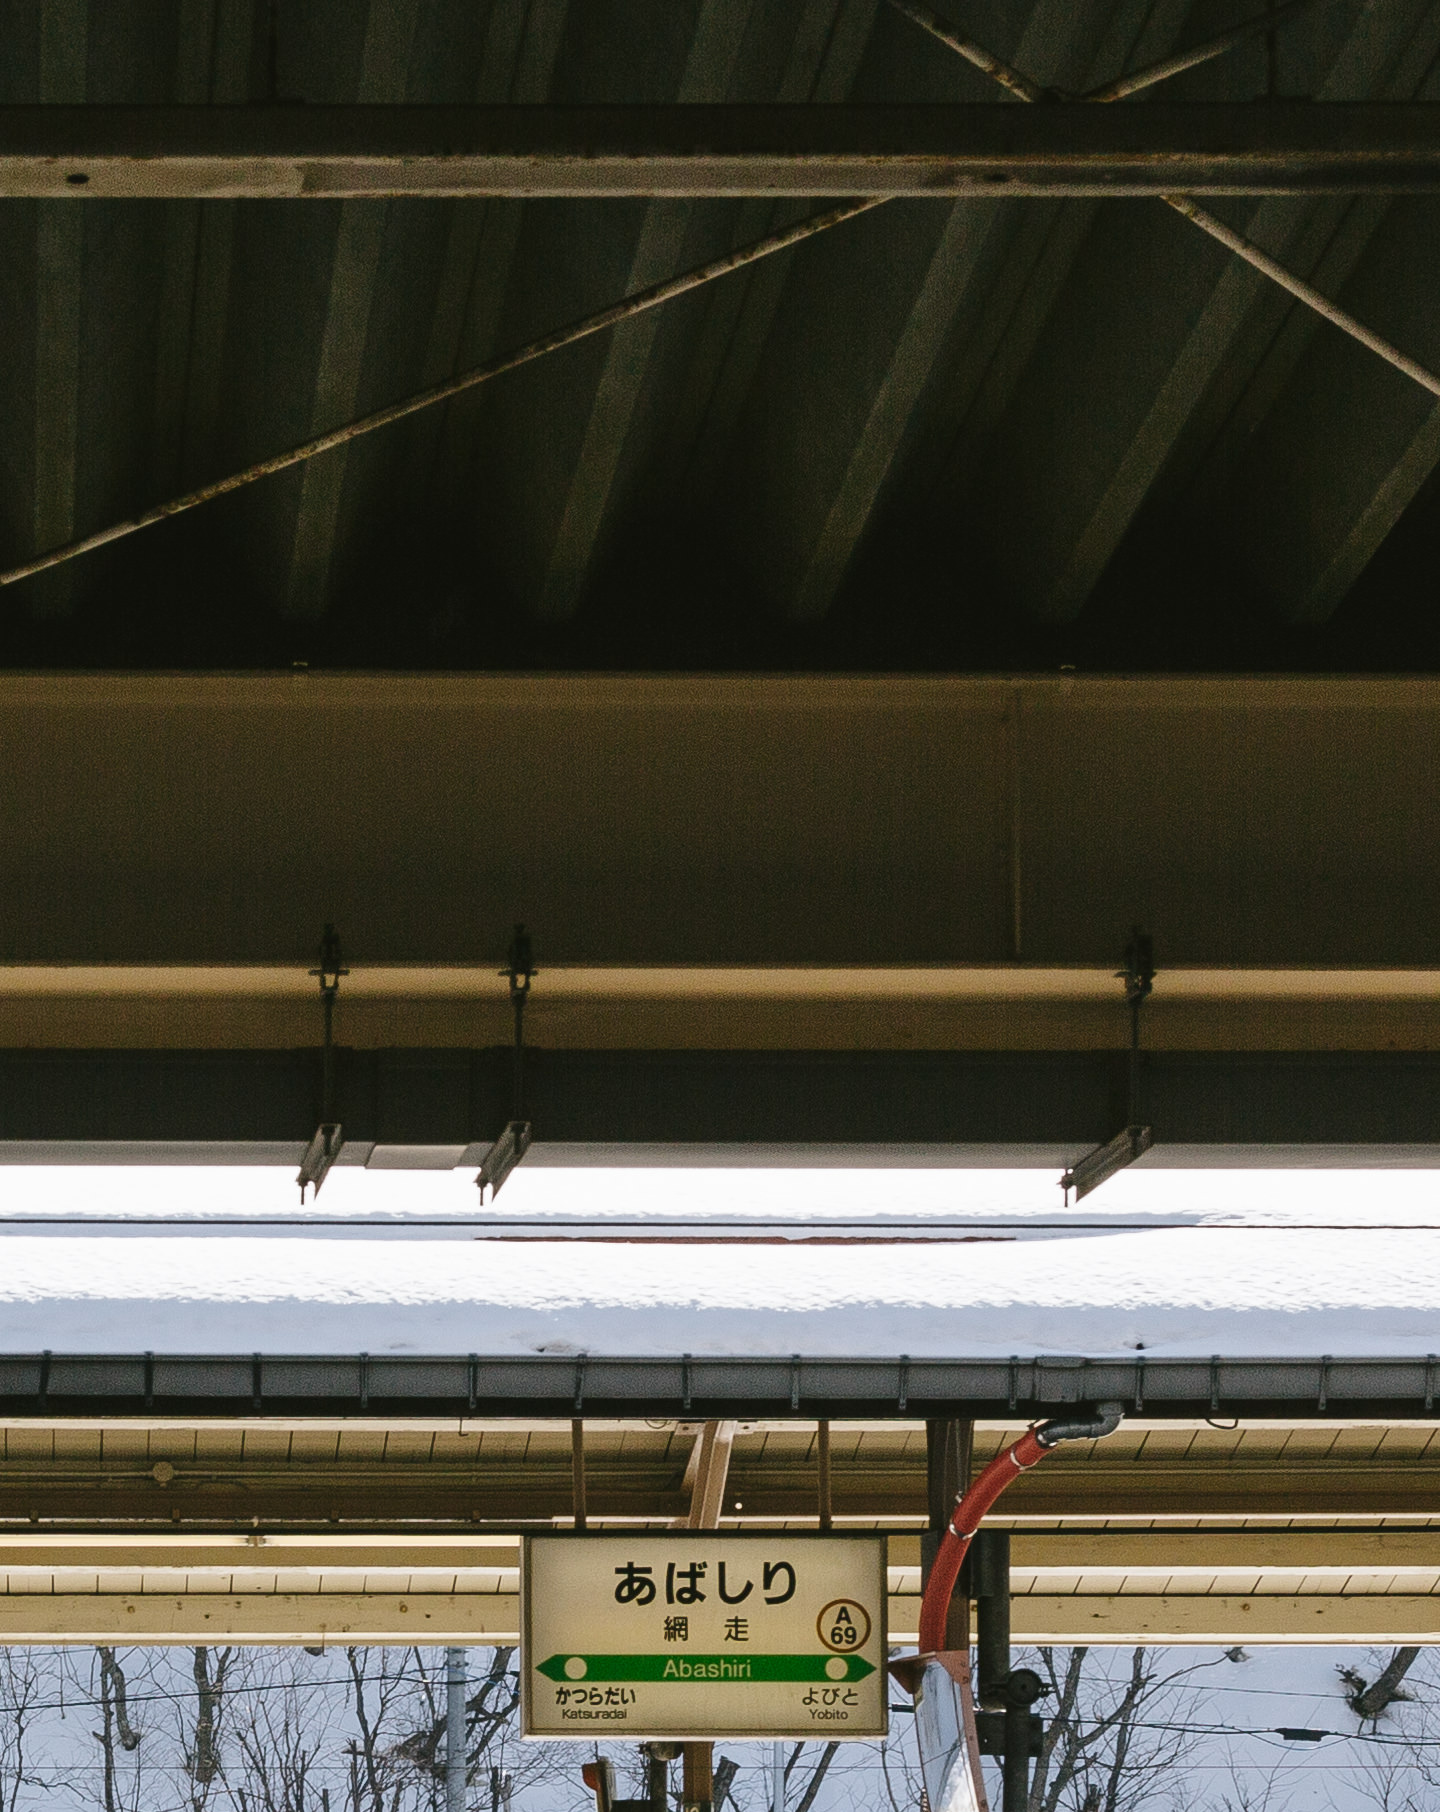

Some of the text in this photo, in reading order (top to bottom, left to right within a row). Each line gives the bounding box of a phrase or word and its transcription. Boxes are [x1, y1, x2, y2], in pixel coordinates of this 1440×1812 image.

[614, 1560, 797, 1607] あばしり
[834, 1607, 853, 1625] A
[830, 1626, 858, 1646] 69
[663, 1658, 752, 1679] Abashiri
[555, 1686, 636, 1706] かつらだい
[801, 1686, 859, 1707] よびと
[561, 1708, 628, 1720] Katsuradai
[809, 1708, 849, 1720] Yobito
